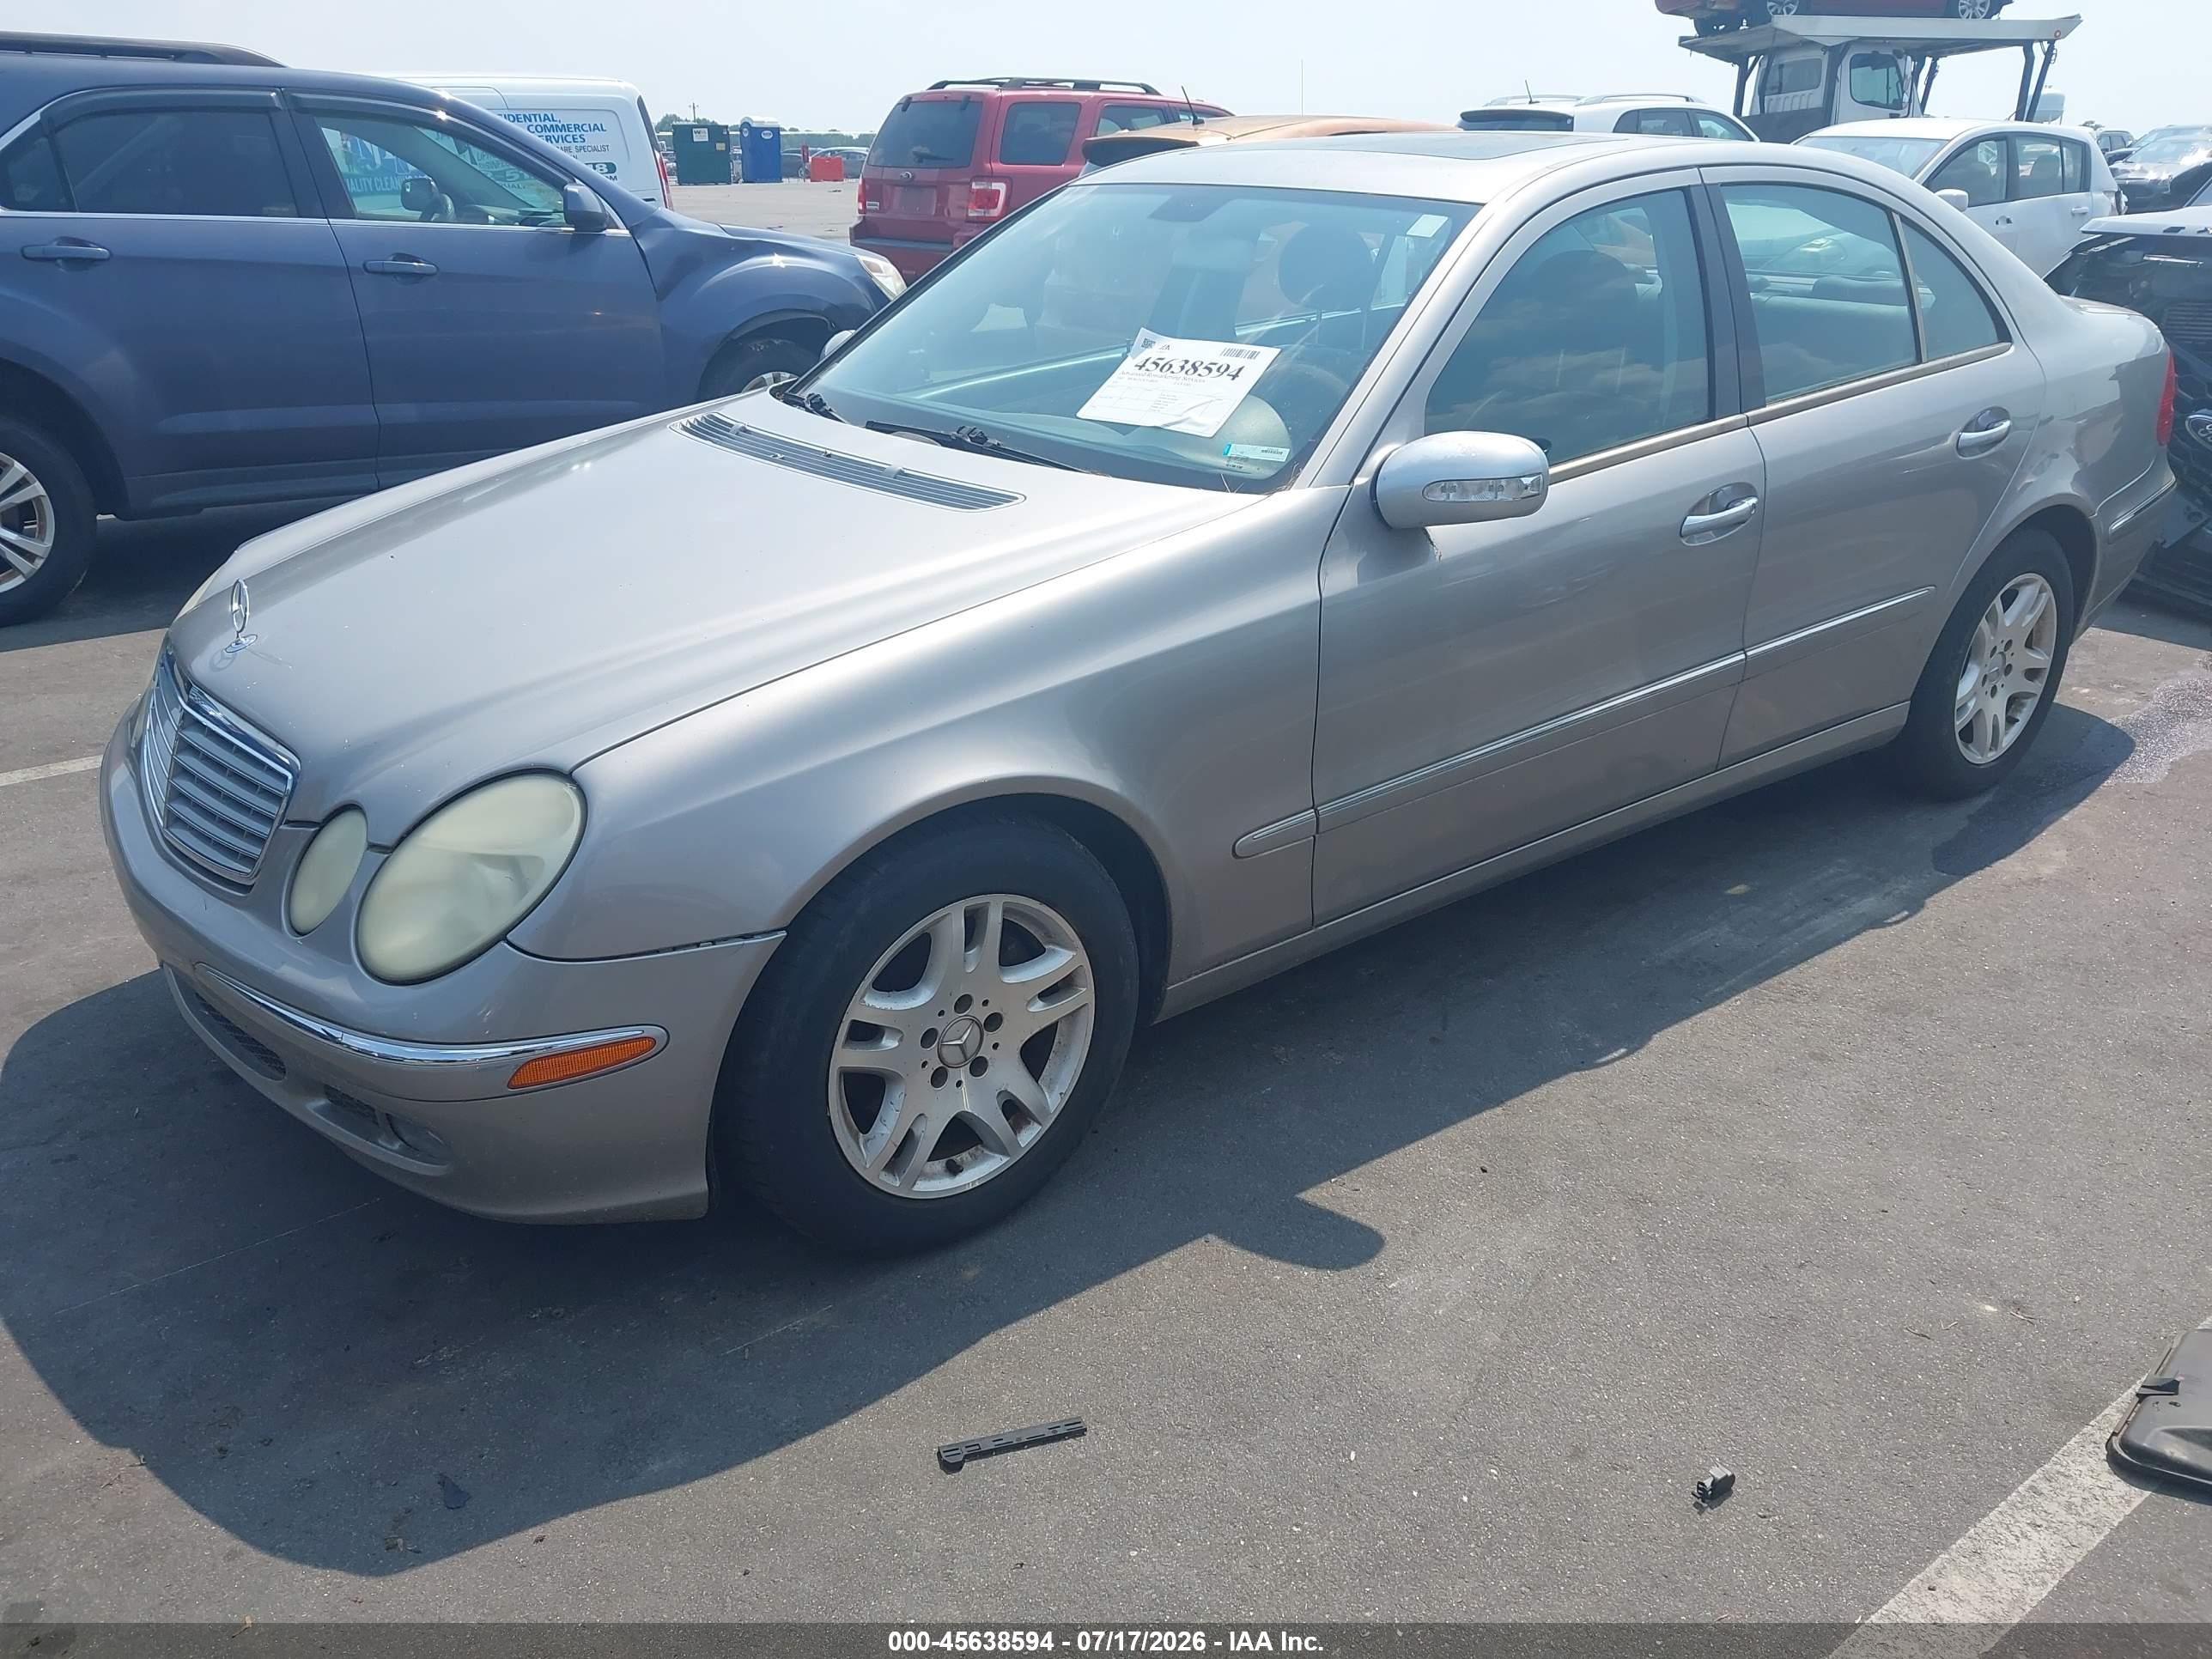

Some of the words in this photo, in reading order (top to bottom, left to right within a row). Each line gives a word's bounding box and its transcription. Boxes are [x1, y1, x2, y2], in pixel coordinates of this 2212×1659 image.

[526, 123, 607, 134] COMMERCIAL
[538, 134, 586, 144] ERVICES
[574, 144, 610, 153] SPECIALIST
[1134, 356, 1245, 380] 45638594
